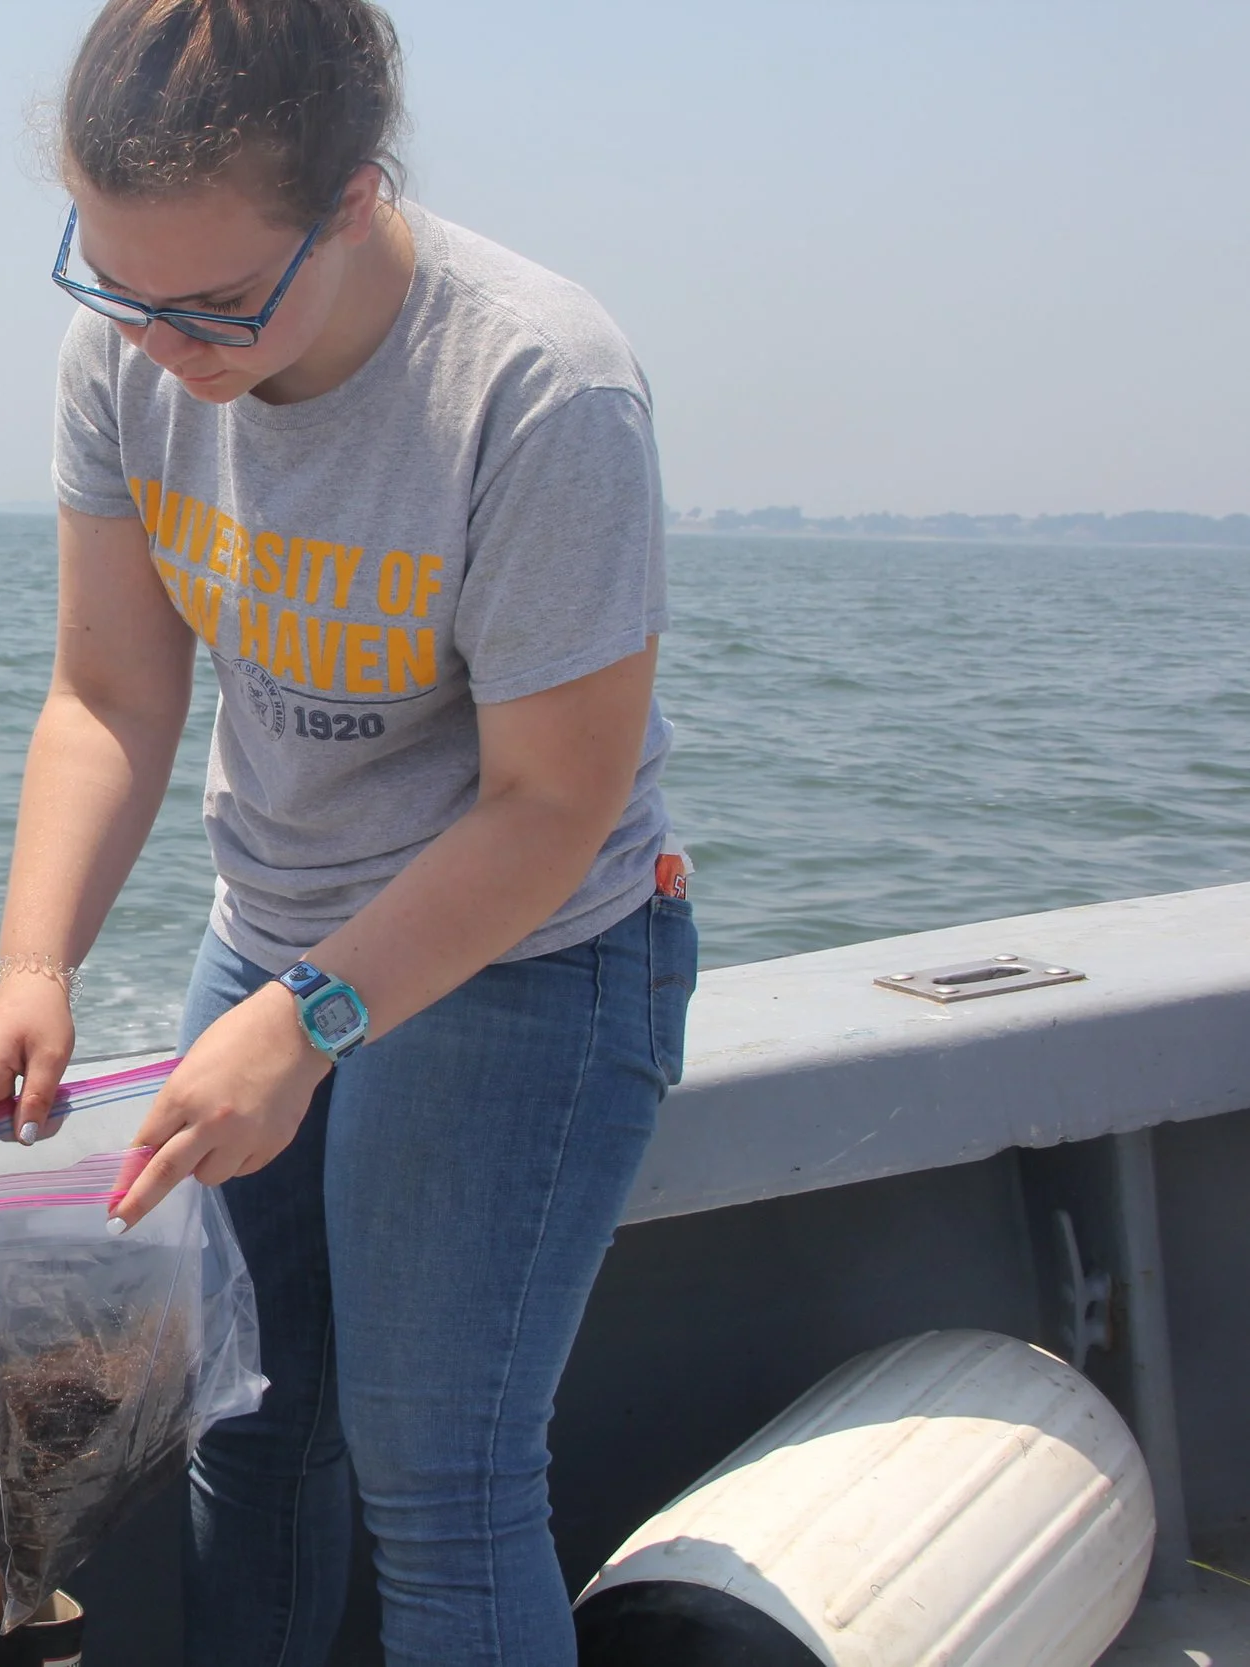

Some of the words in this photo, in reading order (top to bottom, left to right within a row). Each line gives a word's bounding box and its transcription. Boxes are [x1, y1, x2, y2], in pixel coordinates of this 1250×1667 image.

[377, 551, 443, 618] OF
[157, 557, 224, 649] EW
[239, 597, 438, 693] HAVEN
[294, 705, 386, 742] 1920
